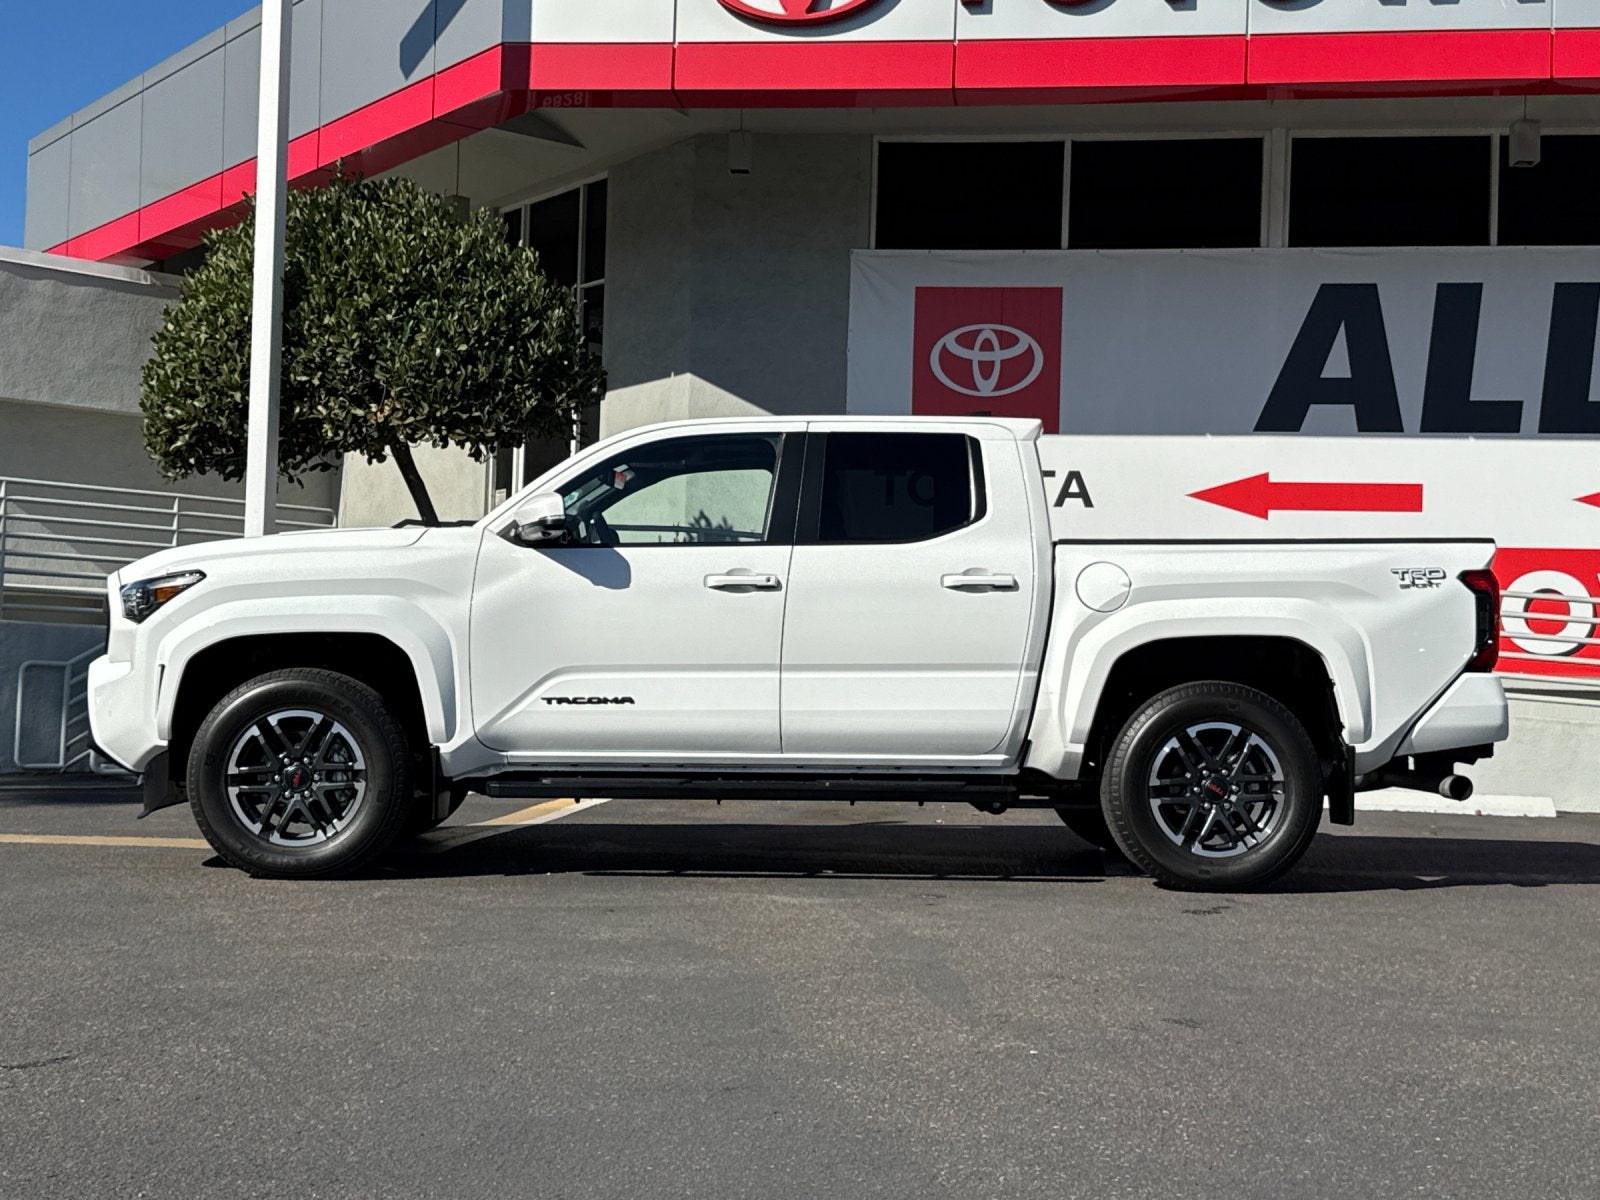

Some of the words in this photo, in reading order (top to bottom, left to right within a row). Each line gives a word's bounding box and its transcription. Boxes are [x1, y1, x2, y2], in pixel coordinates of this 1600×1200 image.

[1252, 282, 1600, 433] ALL
[1390, 567, 1447, 585] TRD
[1501, 570, 1600, 657] O
[540, 697, 635, 705] TACOMA
